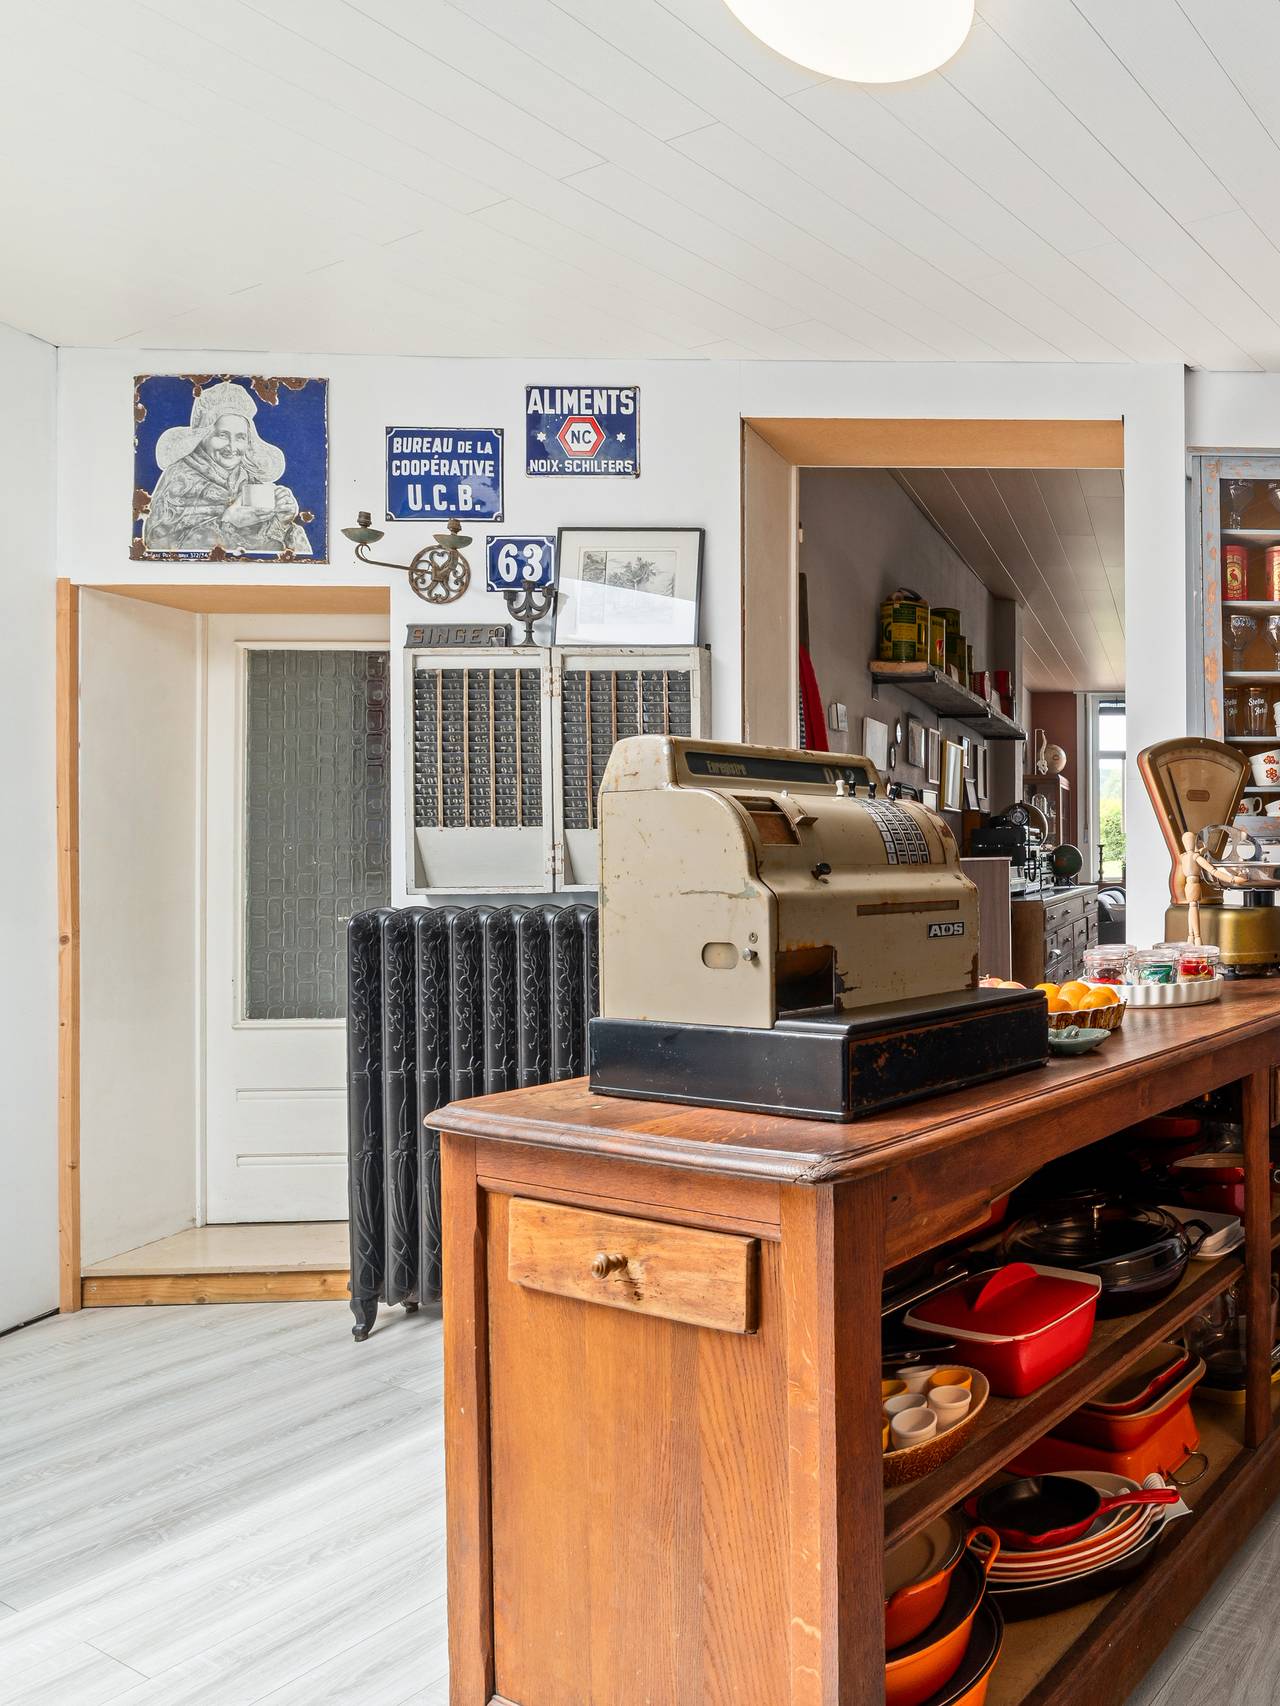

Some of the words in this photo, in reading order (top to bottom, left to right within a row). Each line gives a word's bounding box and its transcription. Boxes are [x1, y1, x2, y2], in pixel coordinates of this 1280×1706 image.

[527, 388, 634, 415] ALIMENTS
[393, 437, 453, 454] BUREAU
[457, 441, 473, 454] DE
[476, 441, 493, 454] LA
[571, 430, 592, 444] NC
[391, 454, 495, 477] COOPÉRATIVE
[407, 483, 481, 511] U.C.B.
[497, 543, 543, 583] 63
[1248, 697, 1265, 706] Stella
[929, 923, 963, 937] ADS
